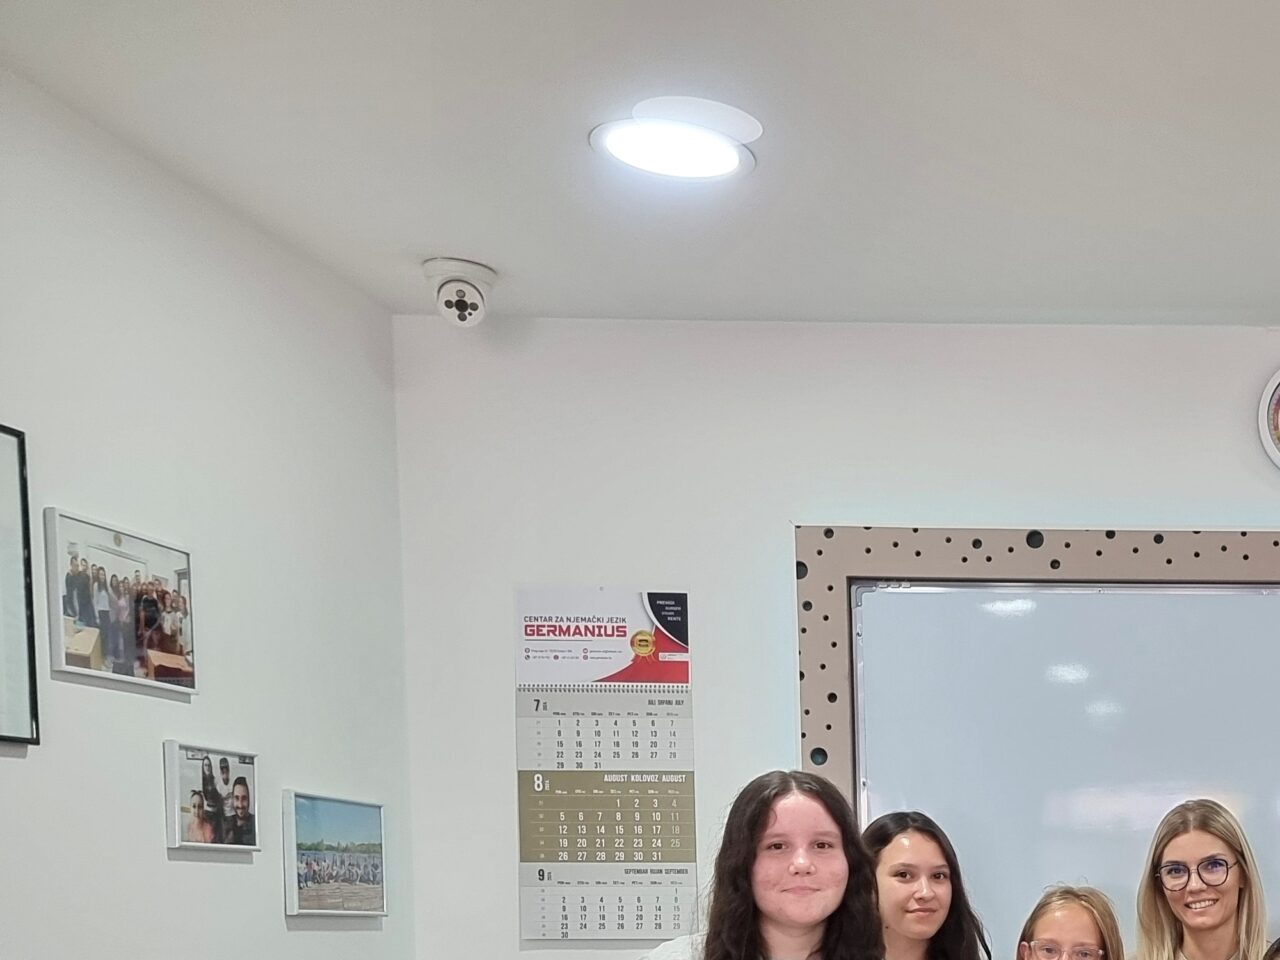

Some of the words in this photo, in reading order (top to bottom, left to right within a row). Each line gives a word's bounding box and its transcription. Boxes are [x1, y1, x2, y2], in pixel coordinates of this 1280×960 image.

[566, 615, 604, 623] NJEMAČKI
[524, 624, 627, 637] GERMANIUS
[533, 699, 540, 712] 7
[604, 774, 628, 782] AUGUST
[631, 774, 658, 782] KOLOVOZ
[534, 774, 543, 791] 8
[652, 812, 660, 820] 10
[559, 825, 567, 834] 12
[578, 826, 586, 834] 13
[597, 826, 604, 834] 14
[616, 826, 623, 834] 15
[634, 826, 642, 834] 16
[653, 826, 661, 834] 17
[560, 839, 568, 847] 19
[577, 839, 586, 847] 20
[596, 839, 604, 847] 21
[615, 839, 624, 847] 22
[634, 839, 642, 847] 23
[652, 839, 661, 847] 24
[559, 852, 568, 860] 26
[578, 852, 586, 860] 27
[596, 852, 606, 860] 28
[615, 852, 624, 860] 29
[634, 852, 643, 860] 30
[652, 852, 661, 860] 31
[538, 869, 544, 881] 9
